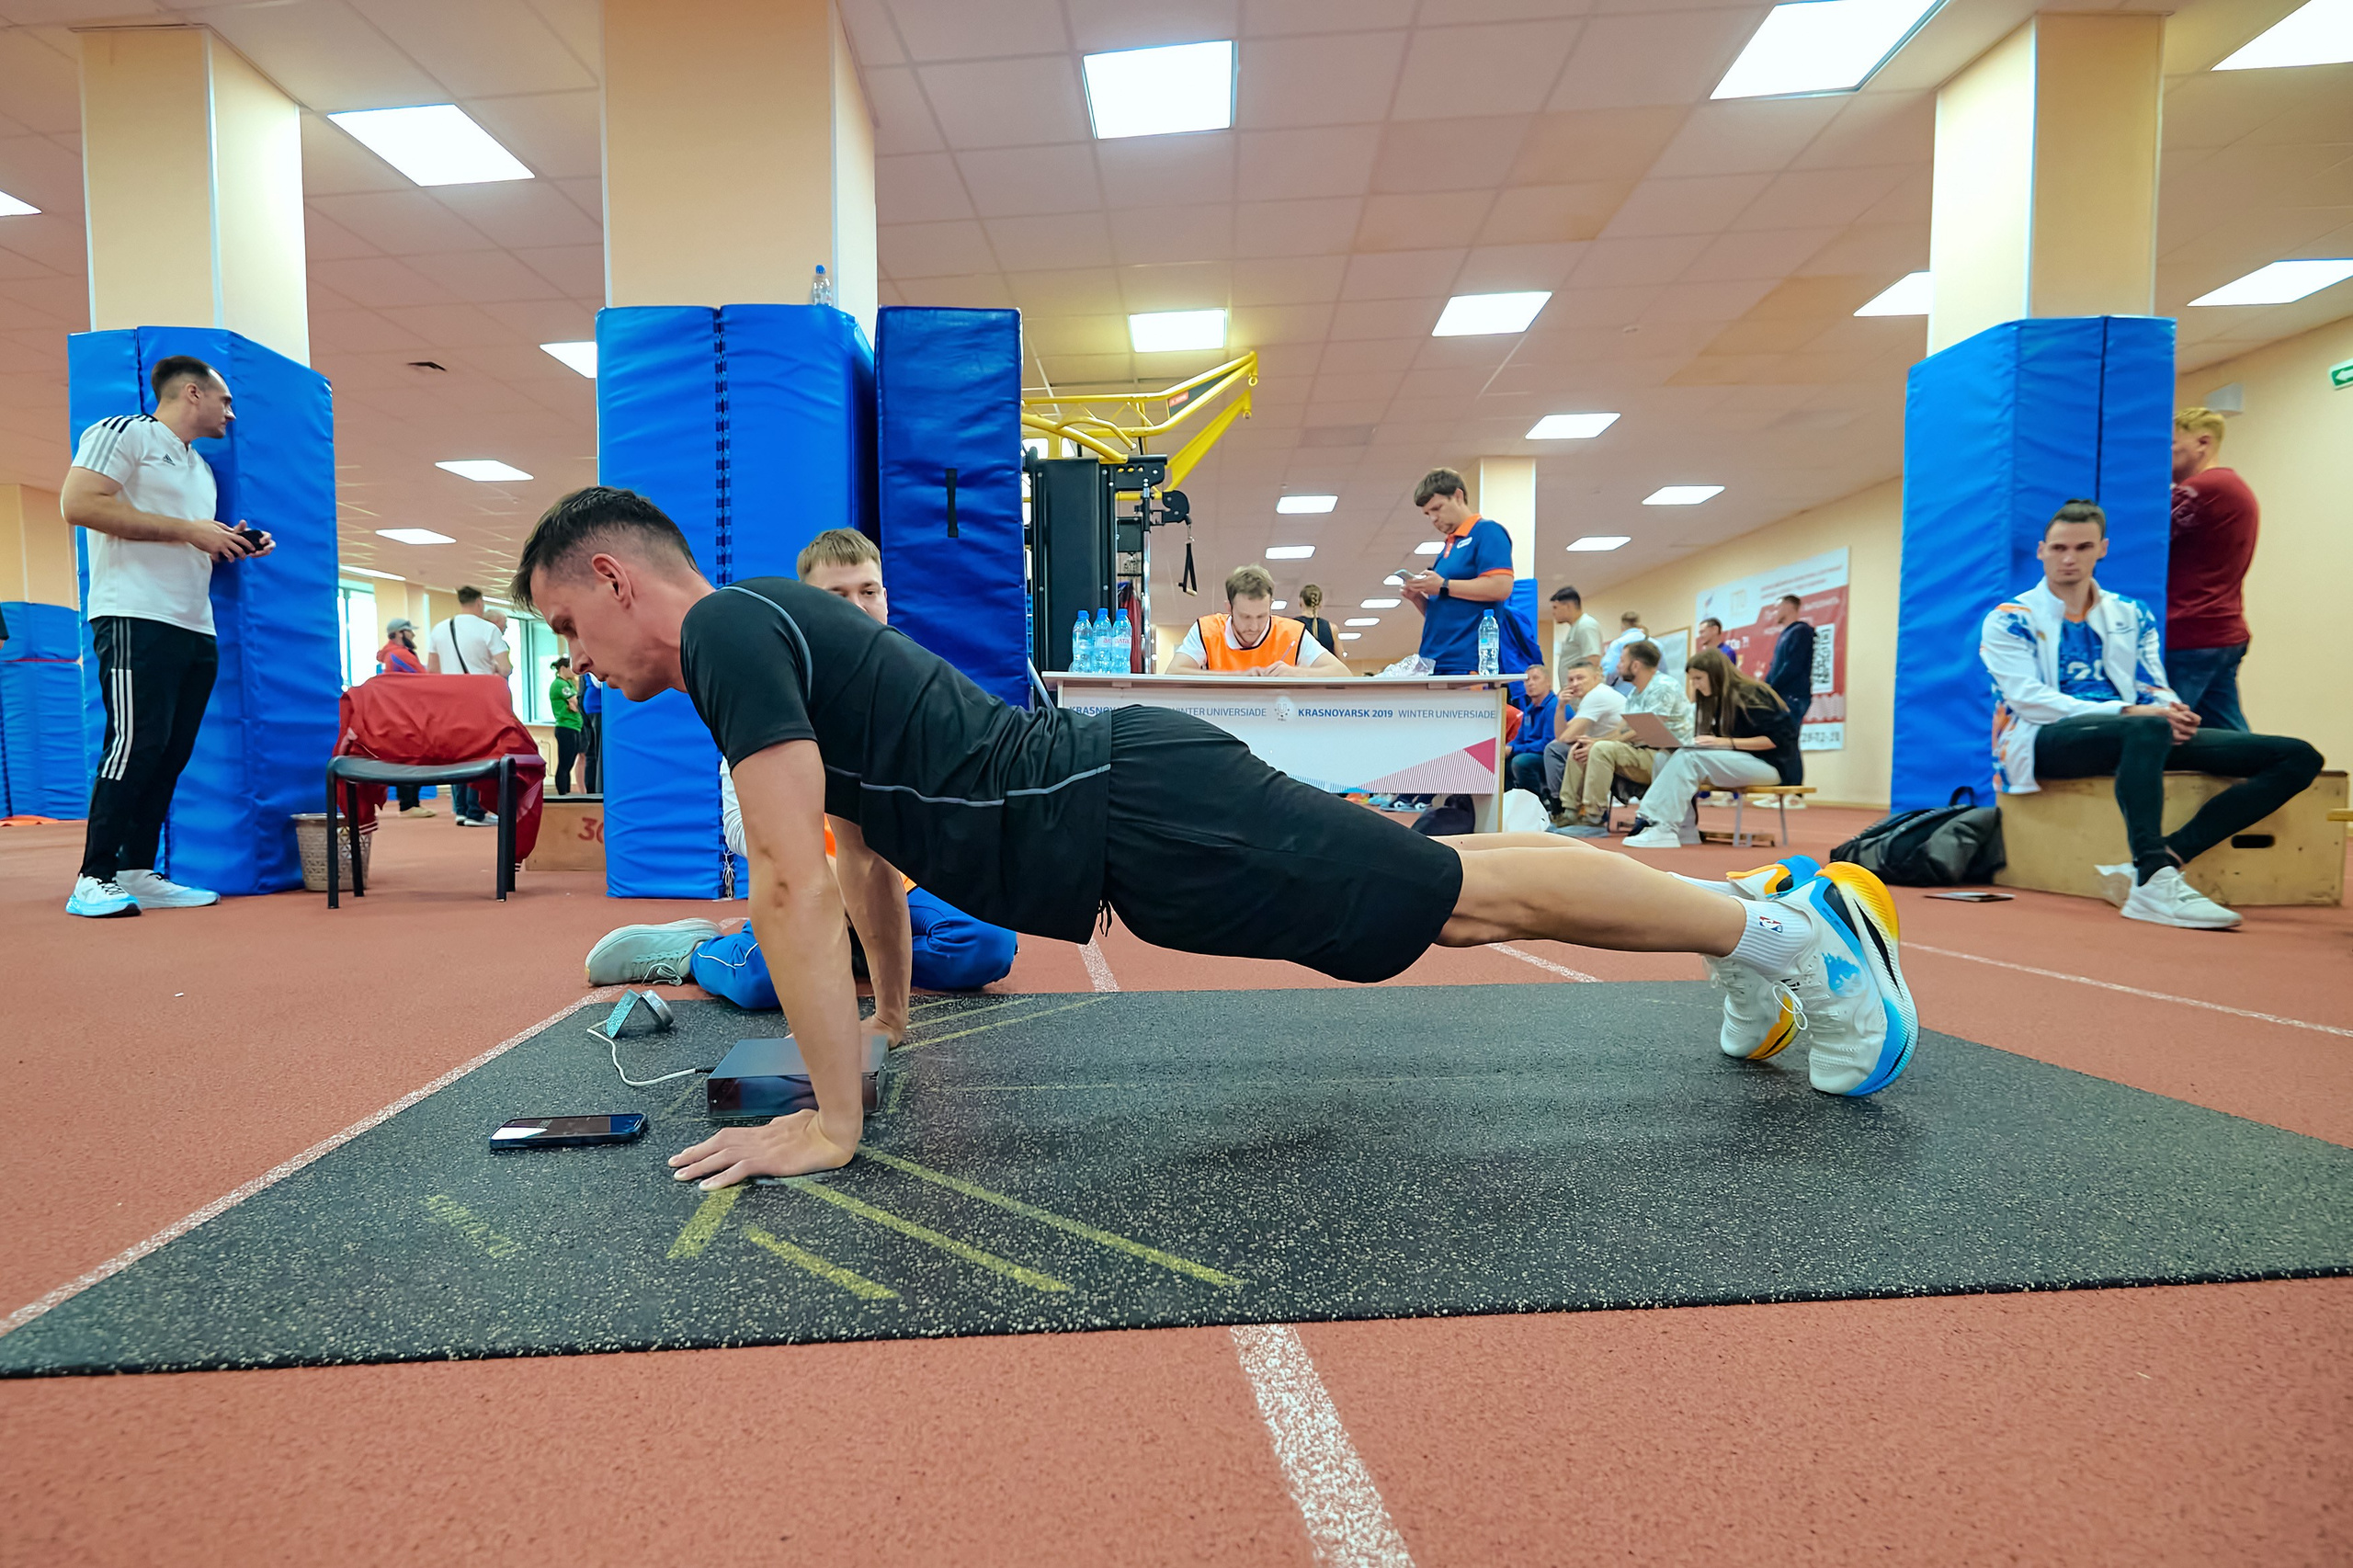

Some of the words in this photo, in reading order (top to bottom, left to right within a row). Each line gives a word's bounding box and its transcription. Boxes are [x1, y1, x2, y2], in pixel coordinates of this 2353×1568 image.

[1206, 707, 1267, 717] UNIVERSIADE
[1298, 708, 1370, 718] KRASNOYARSK
[1372, 710, 1392, 718] 2019
[1398, 709, 1434, 718] WINTER
[1436, 710, 1496, 719] UNIVERSIADE
